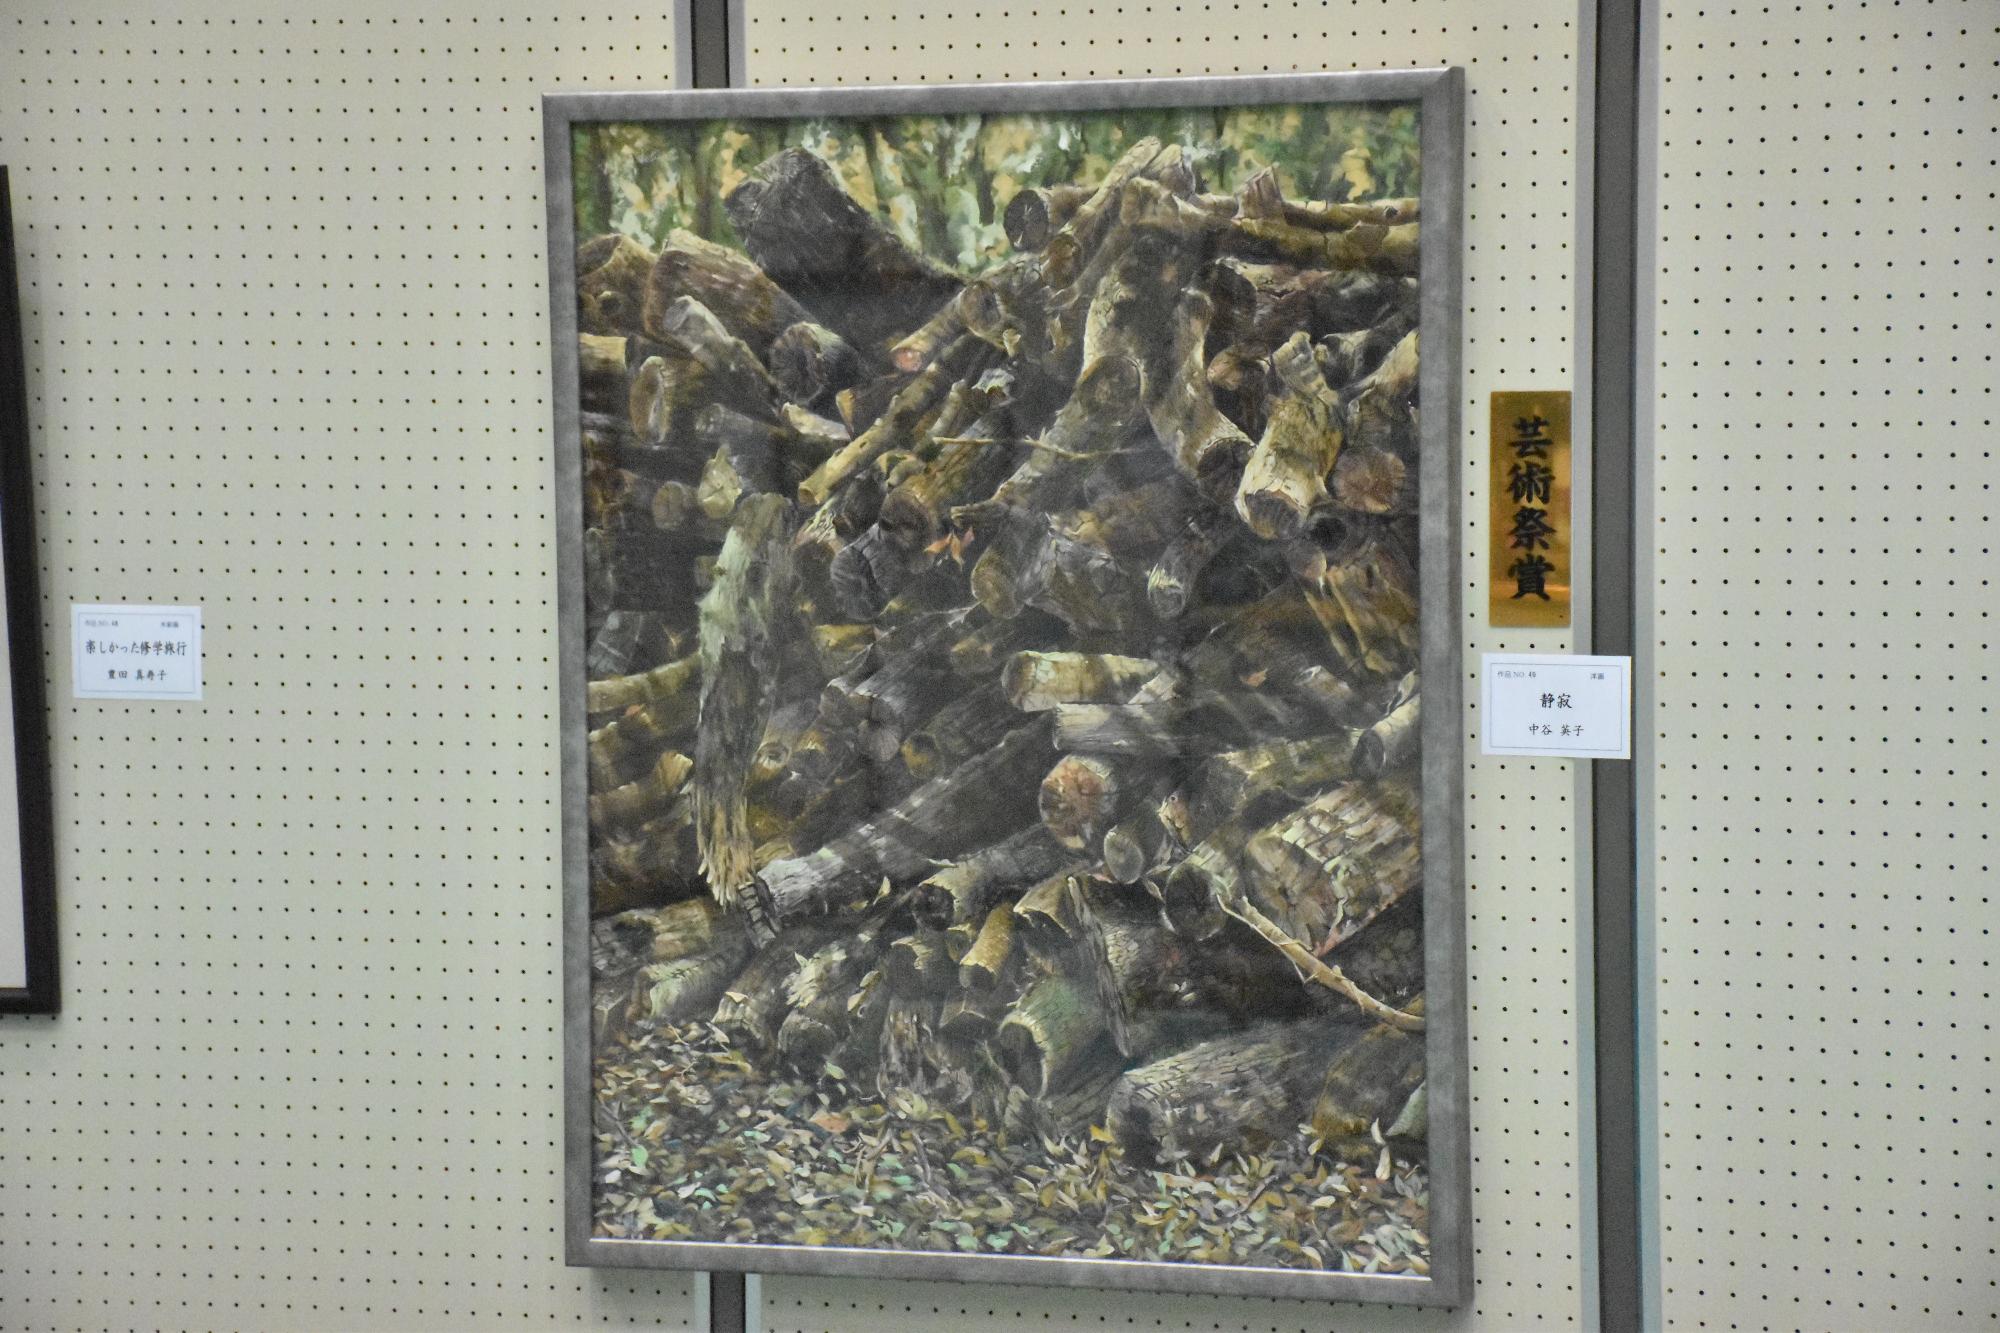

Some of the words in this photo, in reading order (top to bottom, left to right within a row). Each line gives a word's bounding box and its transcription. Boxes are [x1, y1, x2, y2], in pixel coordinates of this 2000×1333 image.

[1506, 415, 1557, 602] 芸術祭賞
[1540, 692, 1573, 709] 静寂
[1529, 723, 1553, 736] 中谷
[1560, 724, 1585, 737] 英子
